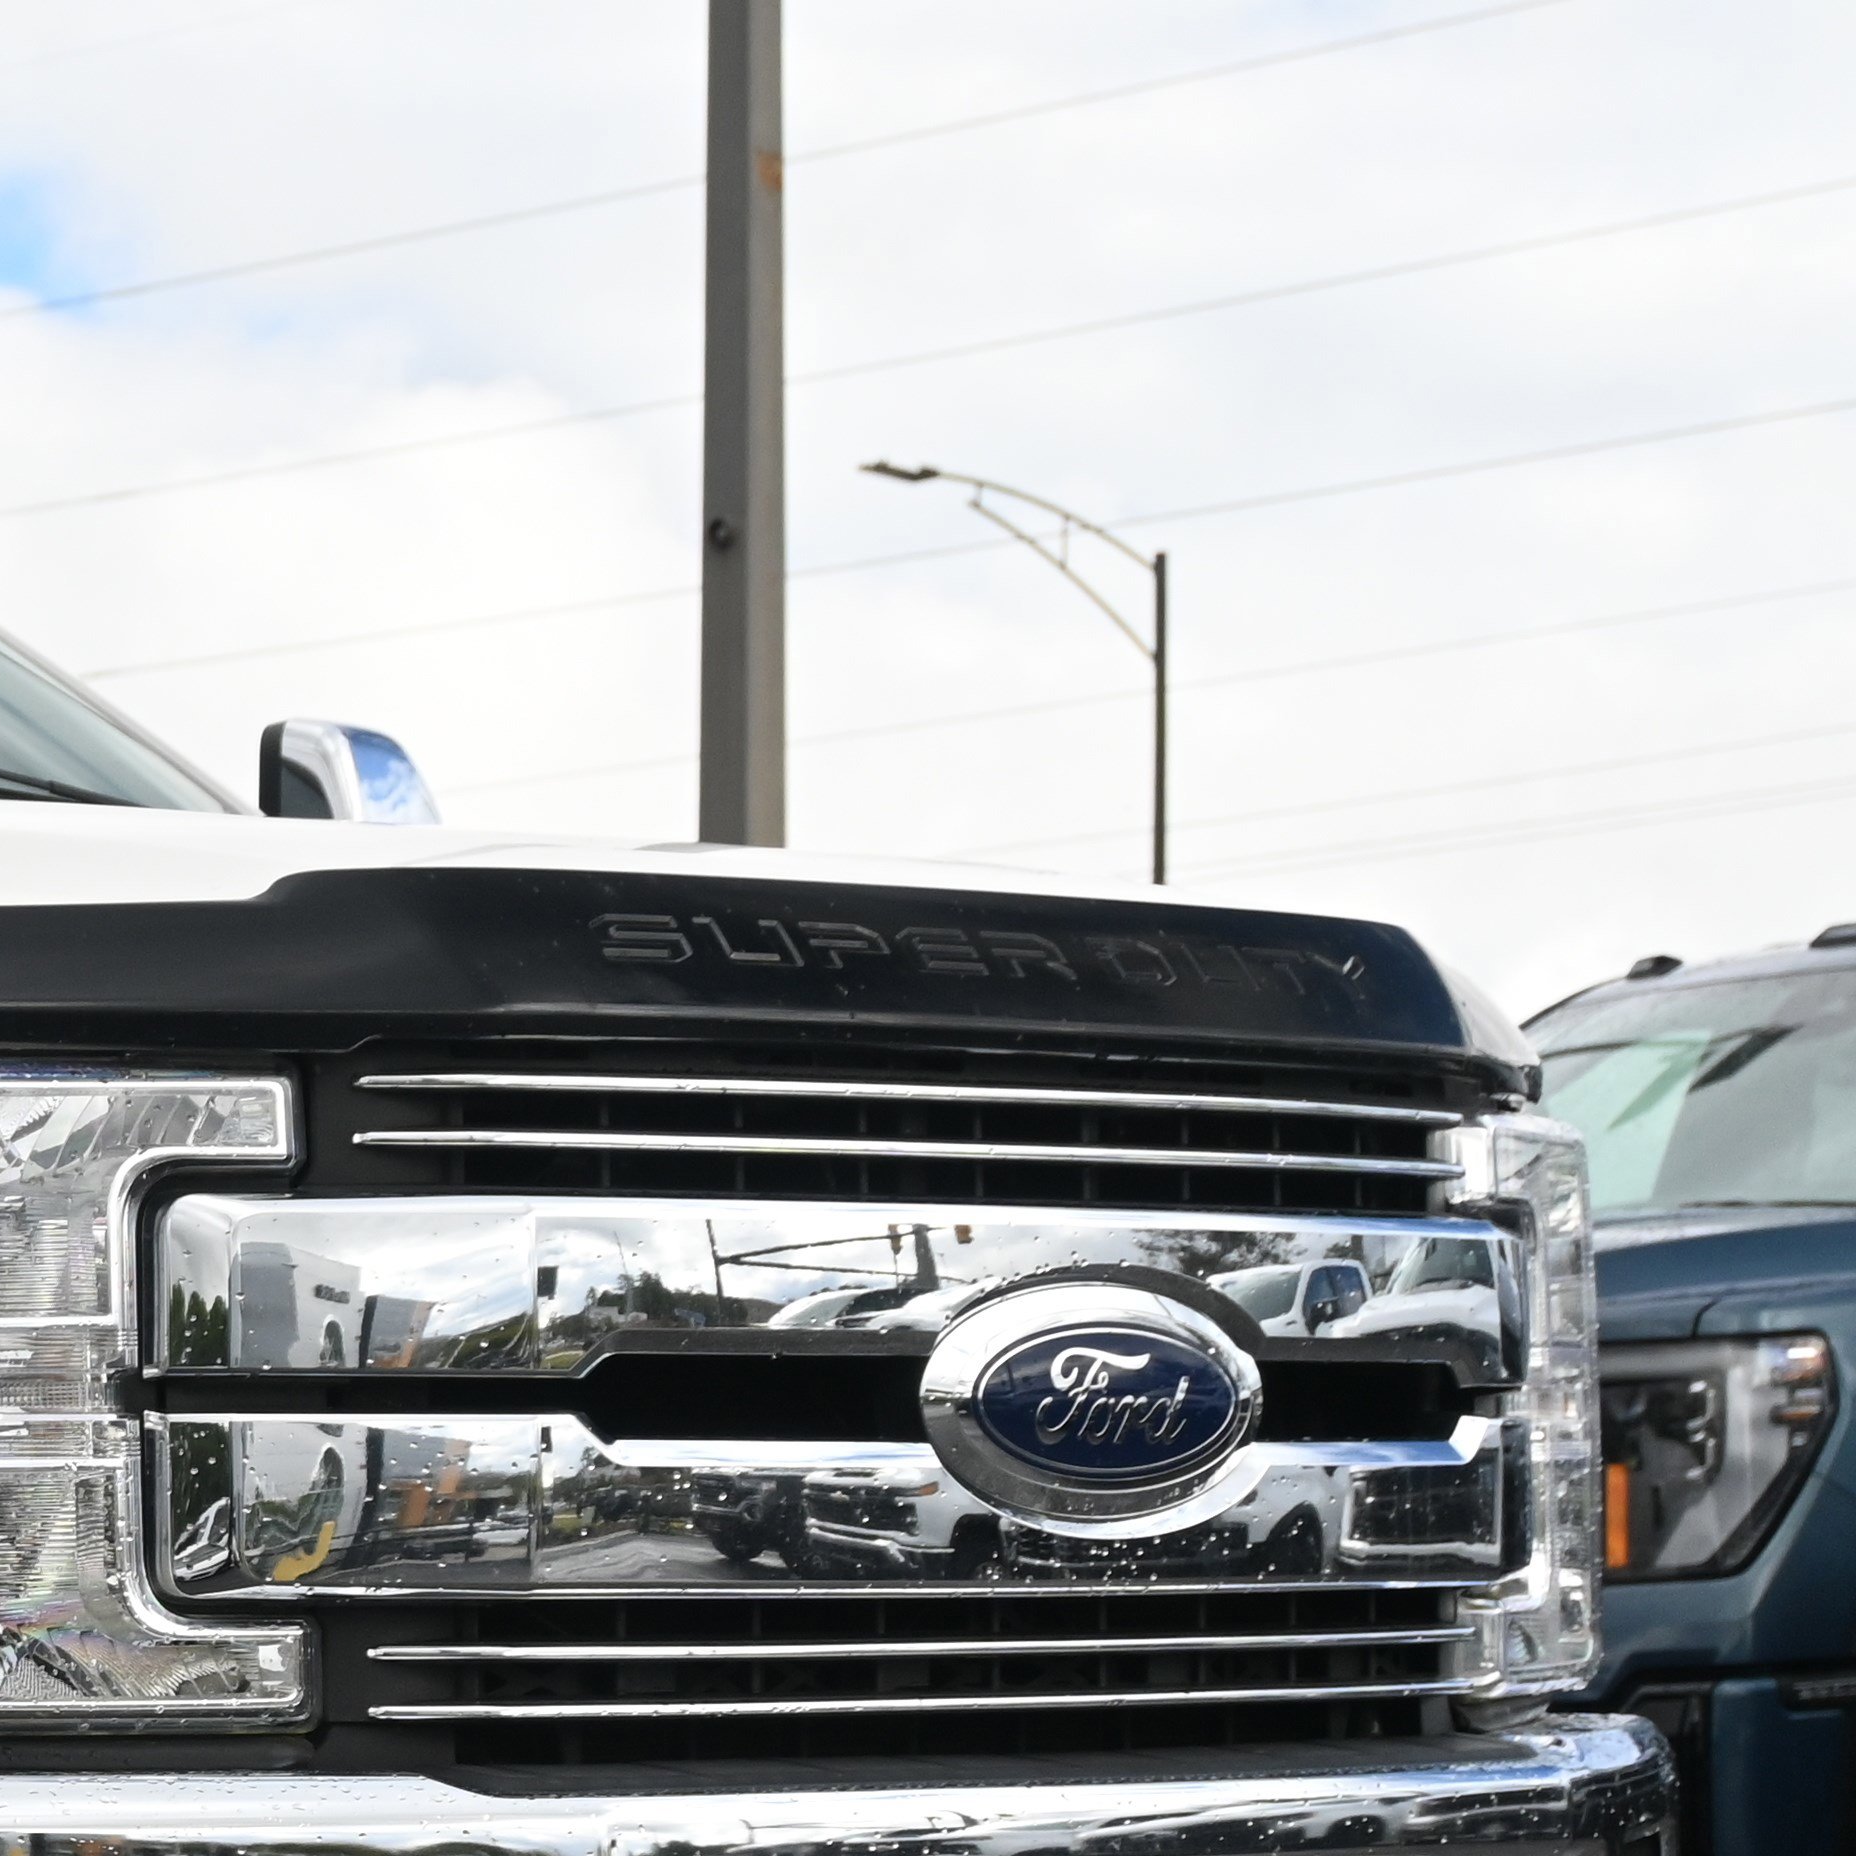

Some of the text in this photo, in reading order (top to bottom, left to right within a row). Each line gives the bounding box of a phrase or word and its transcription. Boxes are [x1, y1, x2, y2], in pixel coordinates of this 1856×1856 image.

[587, 912, 1366, 1008] SUPER DUTY
[1035, 1346, 1191, 1445] Ford
